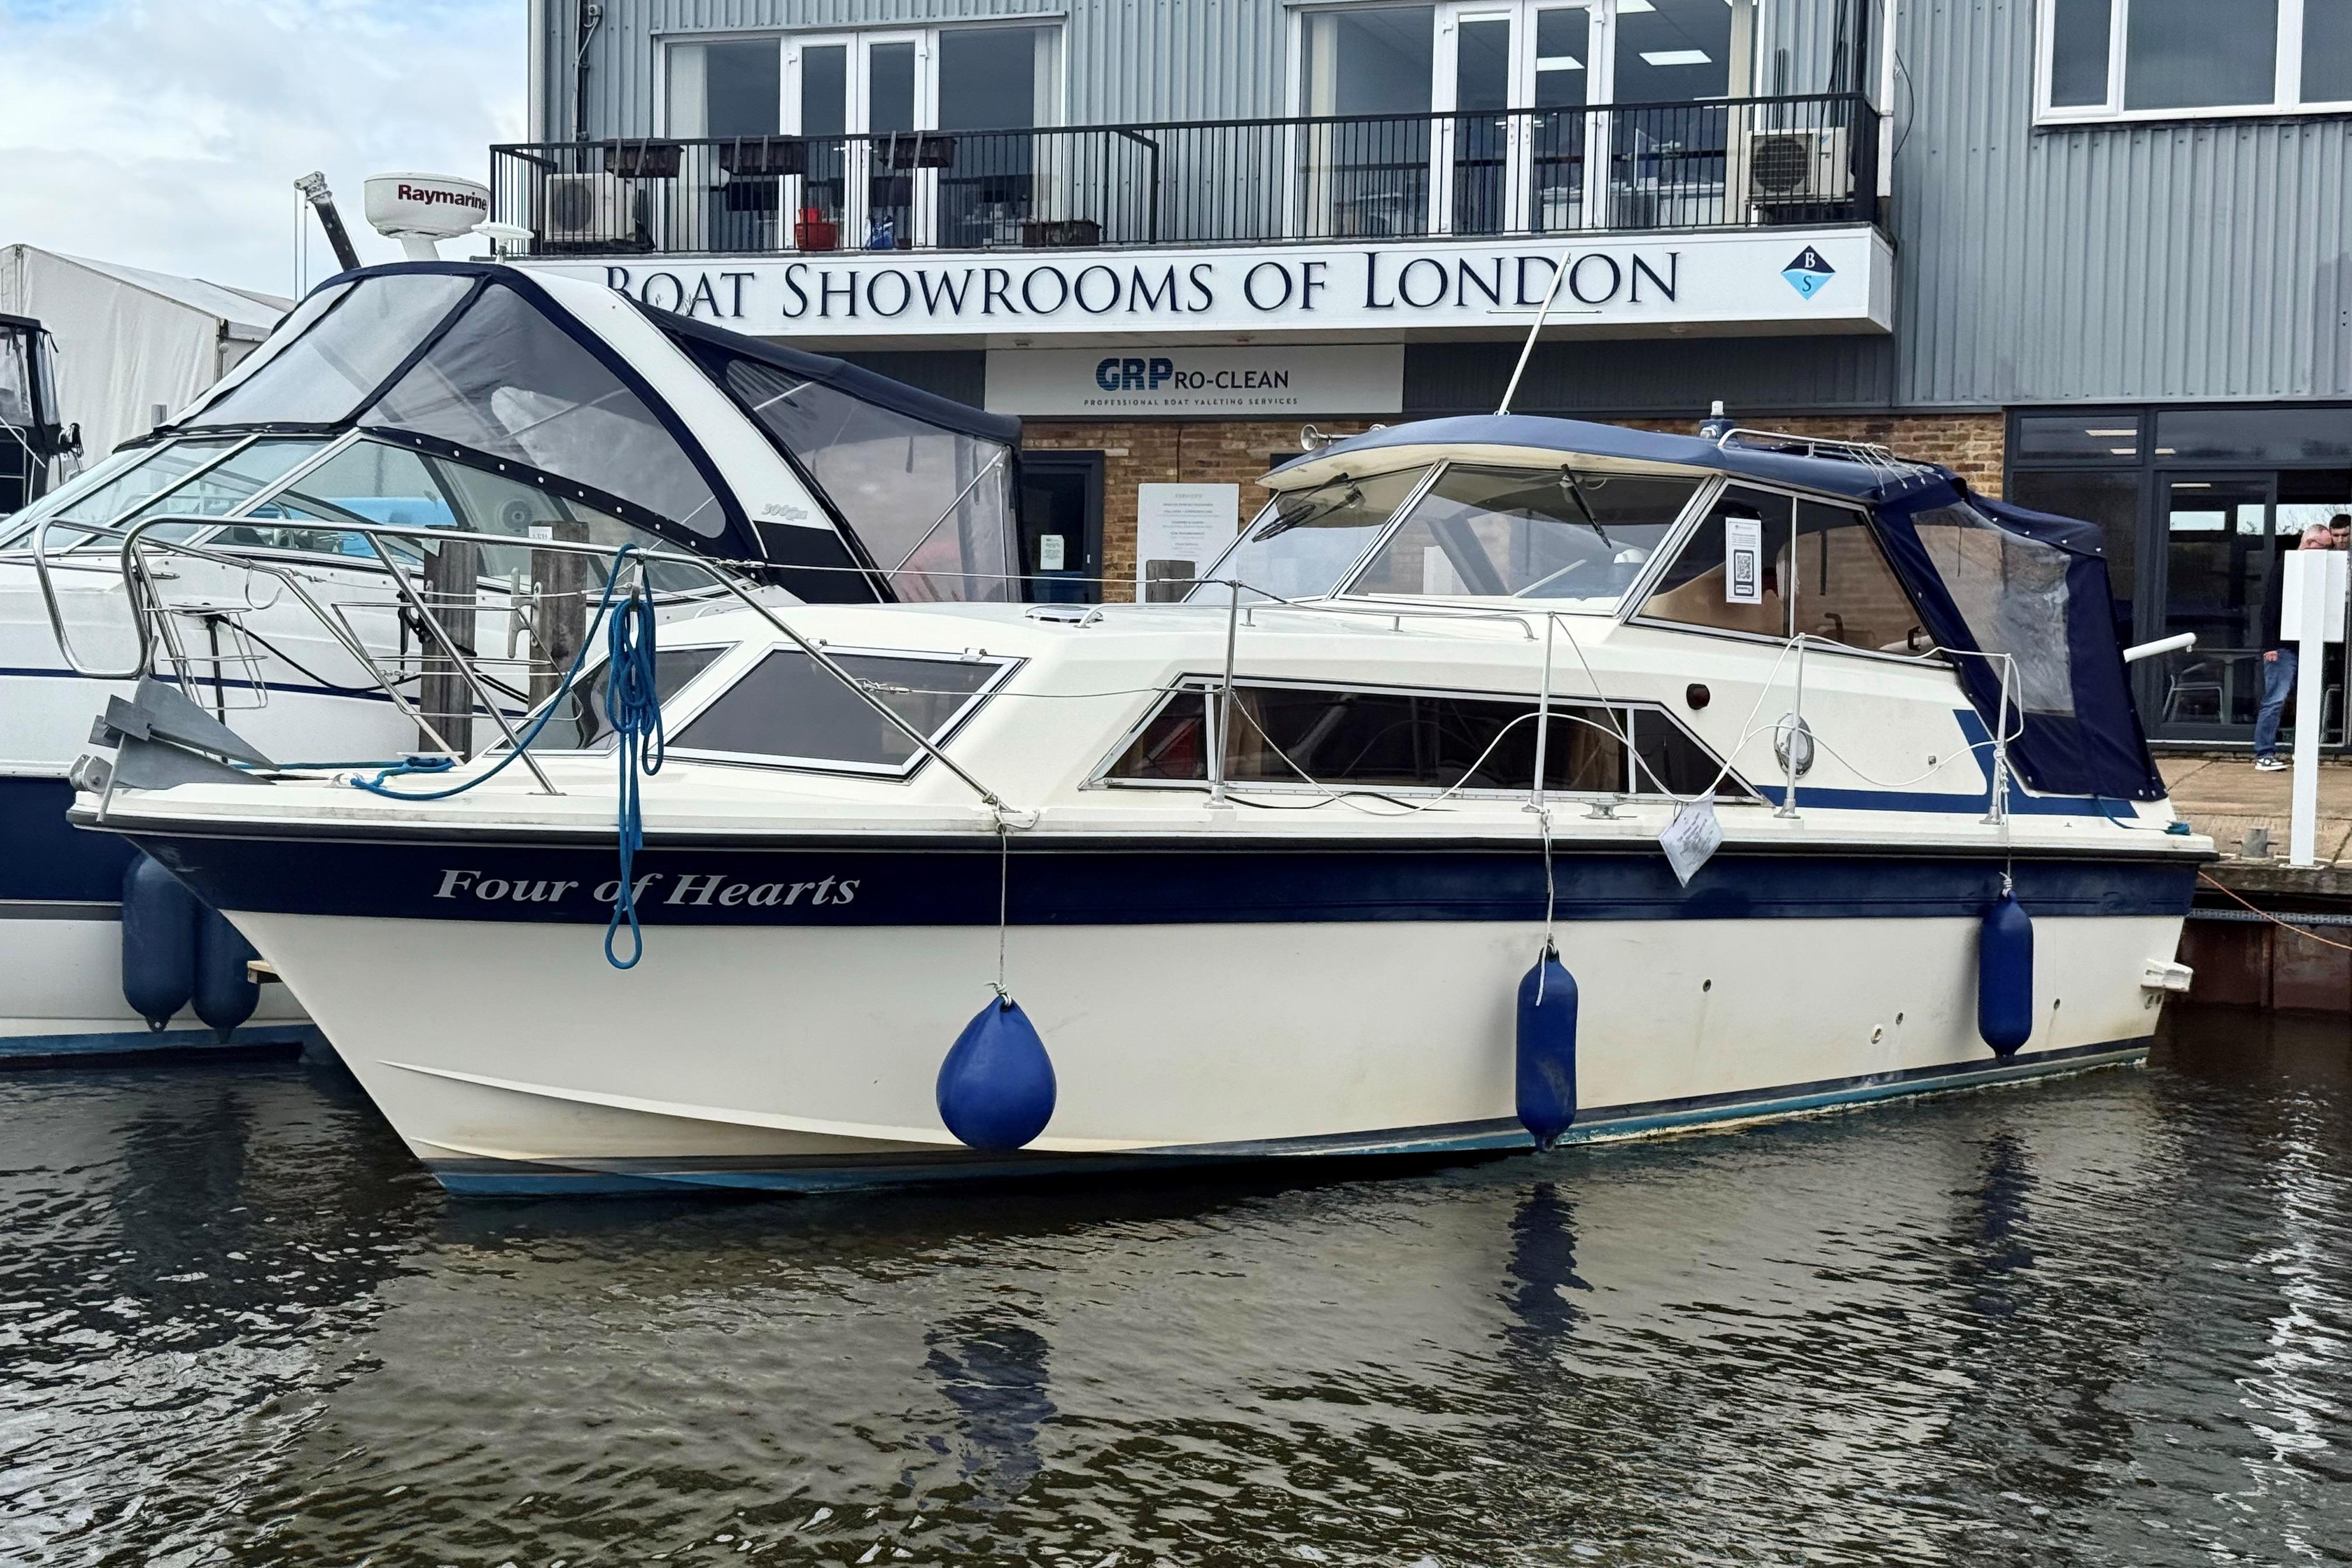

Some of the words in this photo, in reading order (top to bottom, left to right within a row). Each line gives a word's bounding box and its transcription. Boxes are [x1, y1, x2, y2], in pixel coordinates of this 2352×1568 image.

[398, 184, 488, 211] Raymarine
[1804, 252, 1816, 268] B
[783, 263, 1213, 318] SHOWROOMS
[1244, 261, 1327, 311] OF
[1364, 252, 1679, 309] LONDON
[1802, 275, 1812, 292] S
[433, 869, 579, 902] Four
[594, 873, 663, 911] of
[663, 874, 860, 906] Hearts
